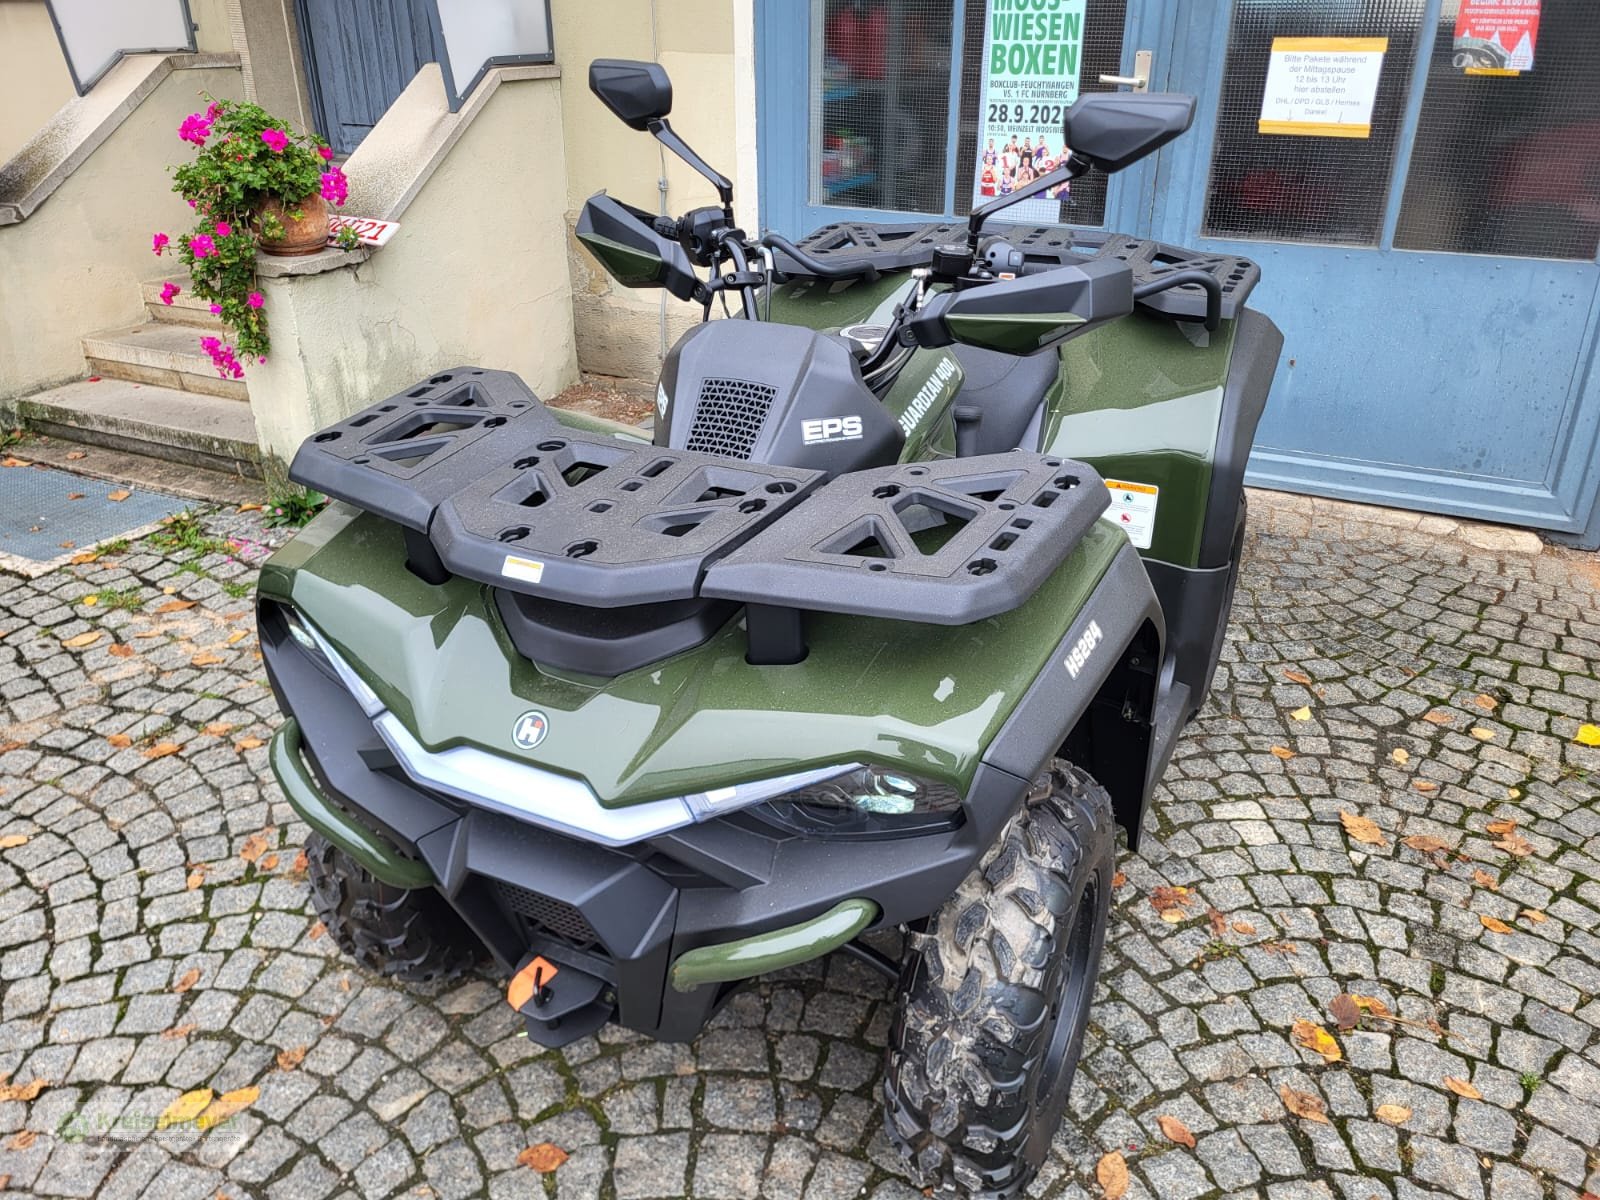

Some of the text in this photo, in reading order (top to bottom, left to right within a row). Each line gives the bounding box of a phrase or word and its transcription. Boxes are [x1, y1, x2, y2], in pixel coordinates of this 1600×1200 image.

[992, 12, 1080, 41] WIESEN
[990, 43, 1079, 76] BOXEN
[1284, 54, 1368, 64] Bitte Pakete während
[1288, 65, 1356, 75] der Mittagspause
[1295, 75, 1347, 84] 12 bis 13 Uhr
[989, 80, 1075, 90] BOXCLUB-FEUCHTWANGEN
[1293, 85, 1346, 94] hier abstellen
[1021, 90, 1030, 98] FC
[1275, 97, 1289, 105] DHL
[935, 356, 956, 381] 400
[802, 415, 863, 441] EPS
[1063, 618, 1104, 681] HS284
